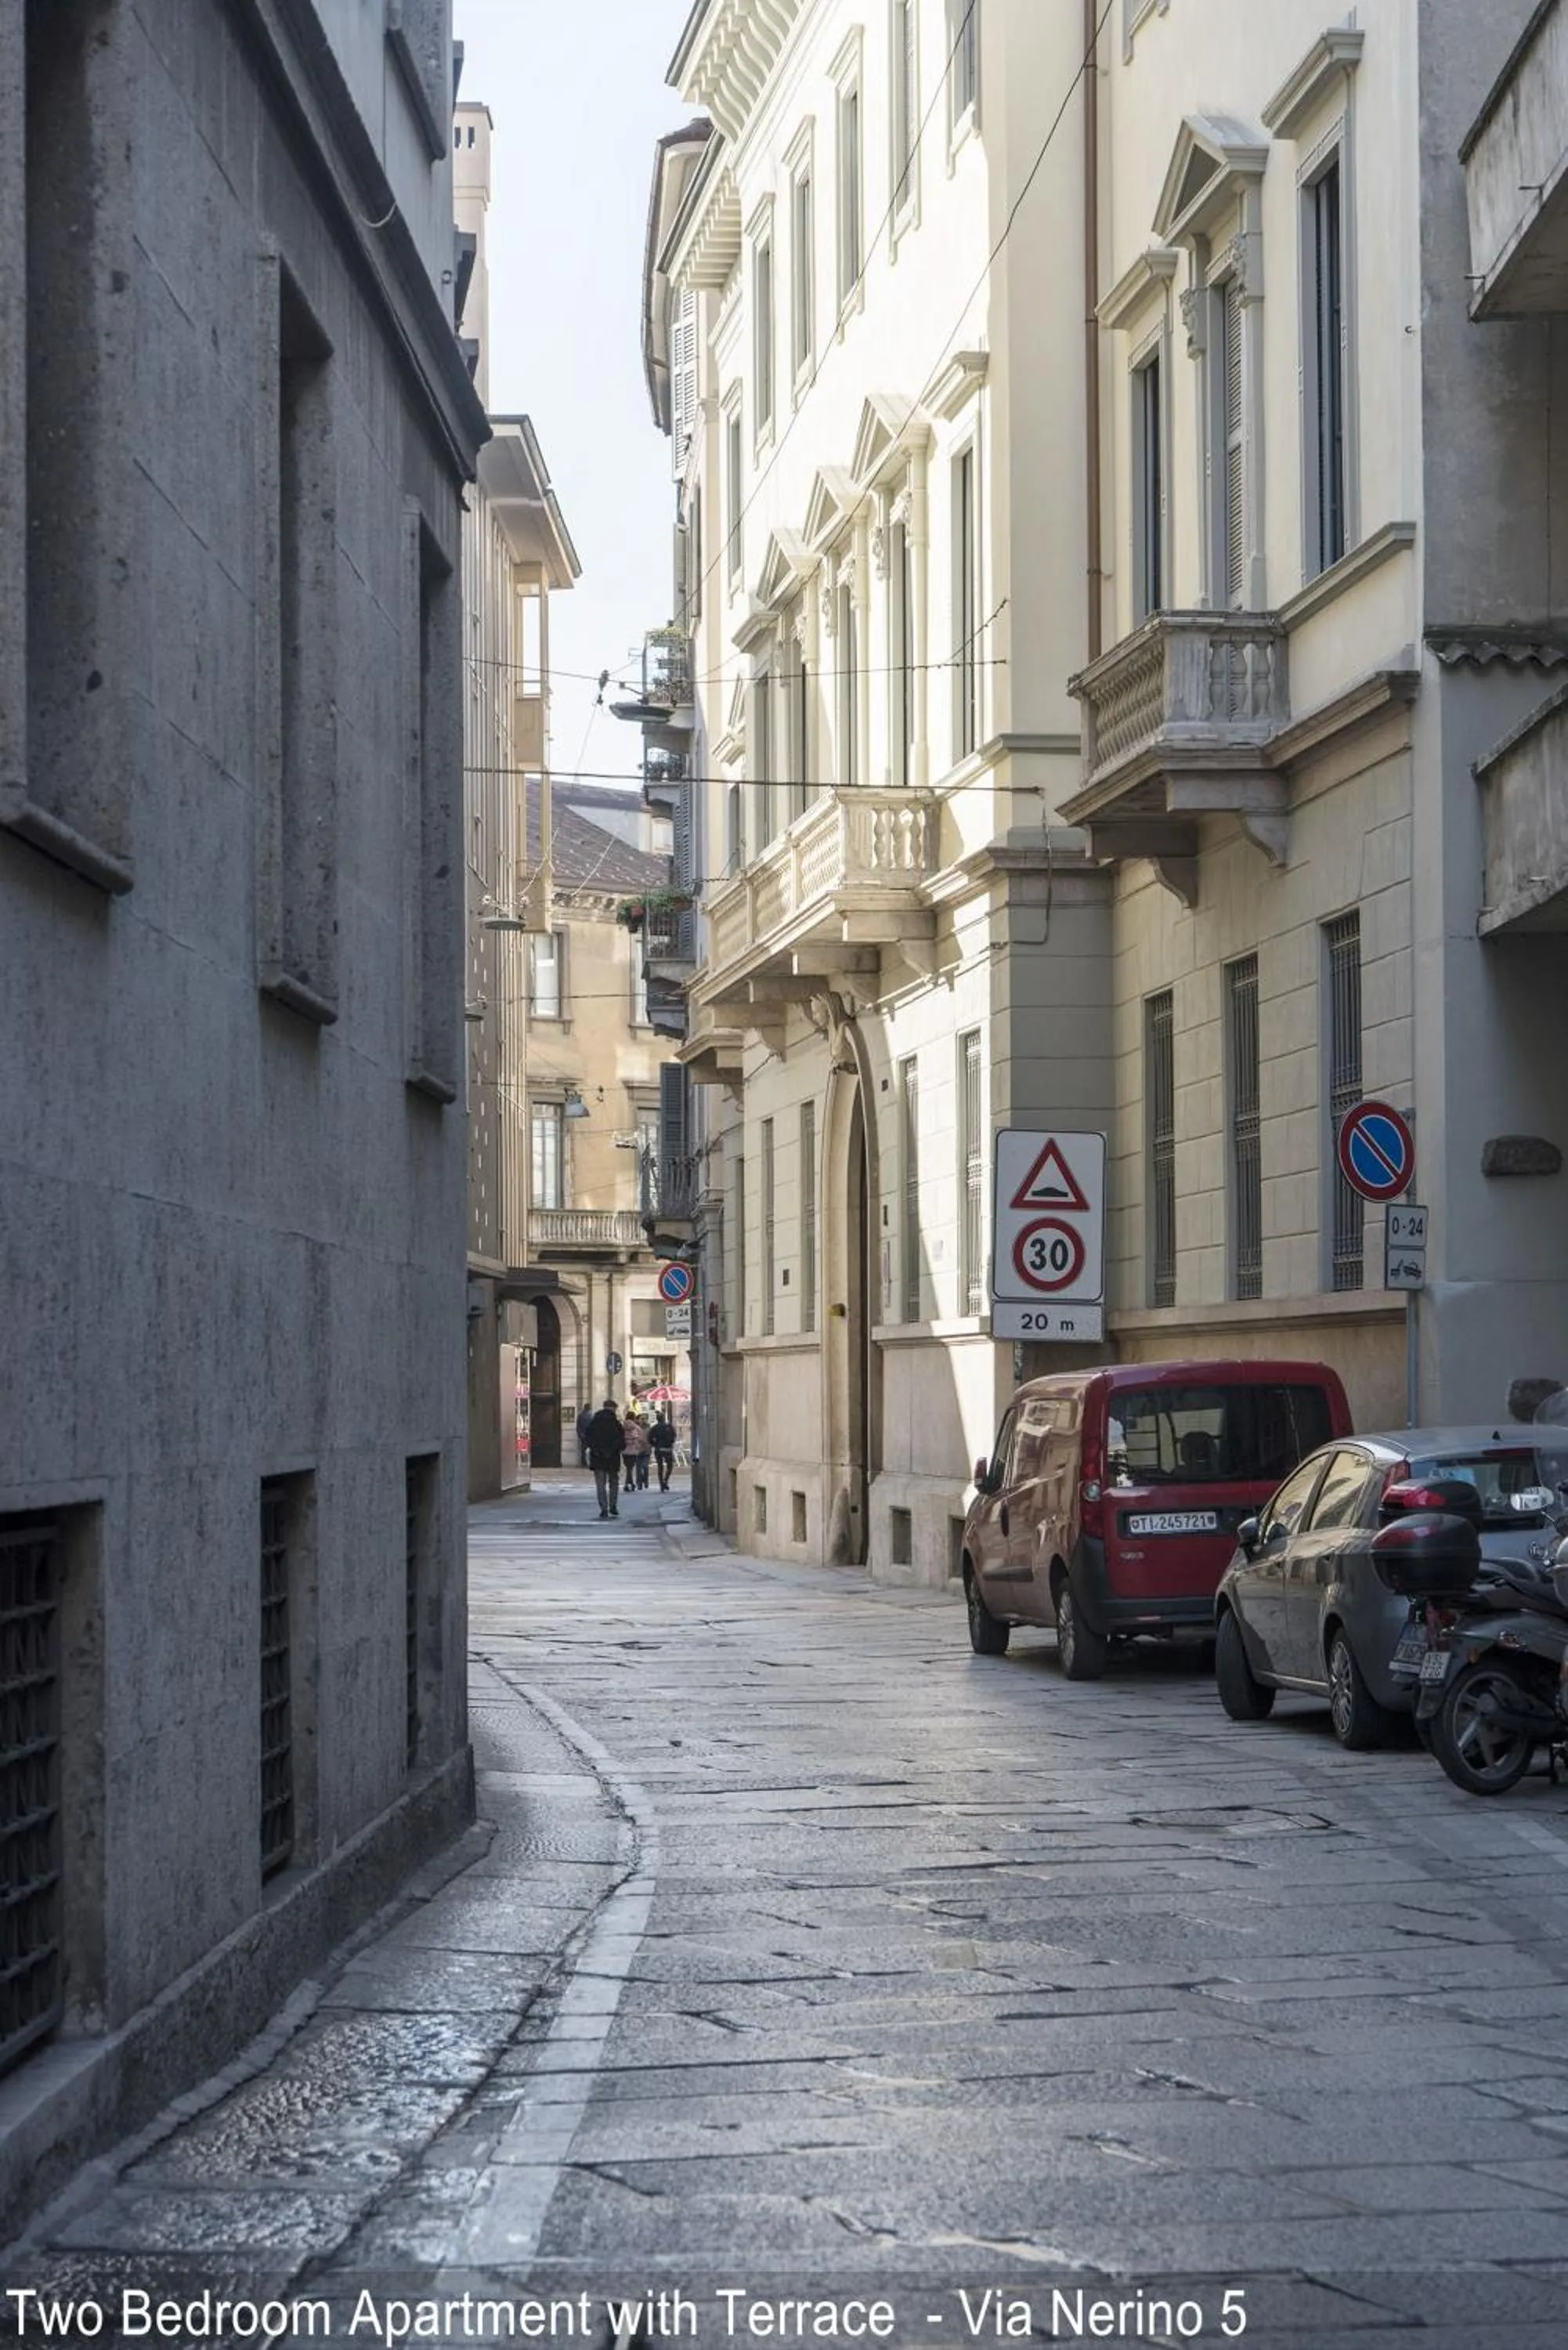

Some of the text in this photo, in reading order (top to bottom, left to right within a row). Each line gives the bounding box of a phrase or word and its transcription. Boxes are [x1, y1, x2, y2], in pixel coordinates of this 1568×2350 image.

[1029, 1238, 1069, 1271] 30
[1021, 1314, 1075, 1331] 20 m
